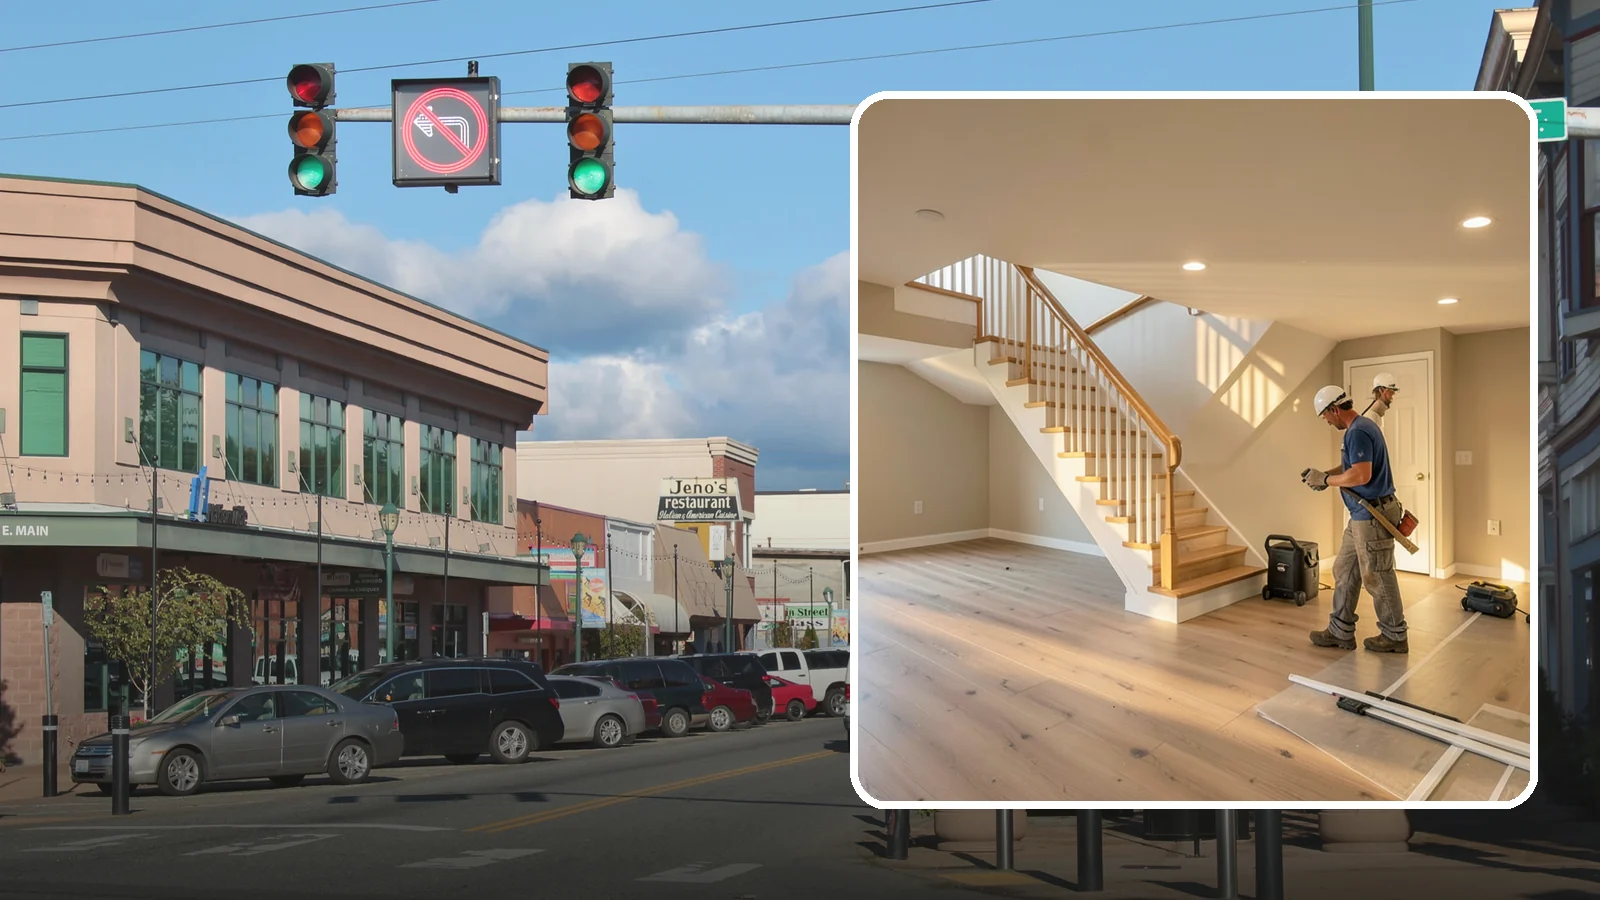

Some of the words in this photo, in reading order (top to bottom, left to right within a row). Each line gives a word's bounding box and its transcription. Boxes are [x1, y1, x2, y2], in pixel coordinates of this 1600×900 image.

[670, 480, 728, 495] Jeno's
[664, 496, 731, 509] restaurant
[658, 510, 682, 519] Italian
[685, 509, 715, 519] American
[714, 509, 738, 519] Cuisine
[2, 525, 13, 536] E.
[15, 525, 49, 537] MAIN
[797, 607, 829, 617] Street
[790, 619, 824, 627] lass
